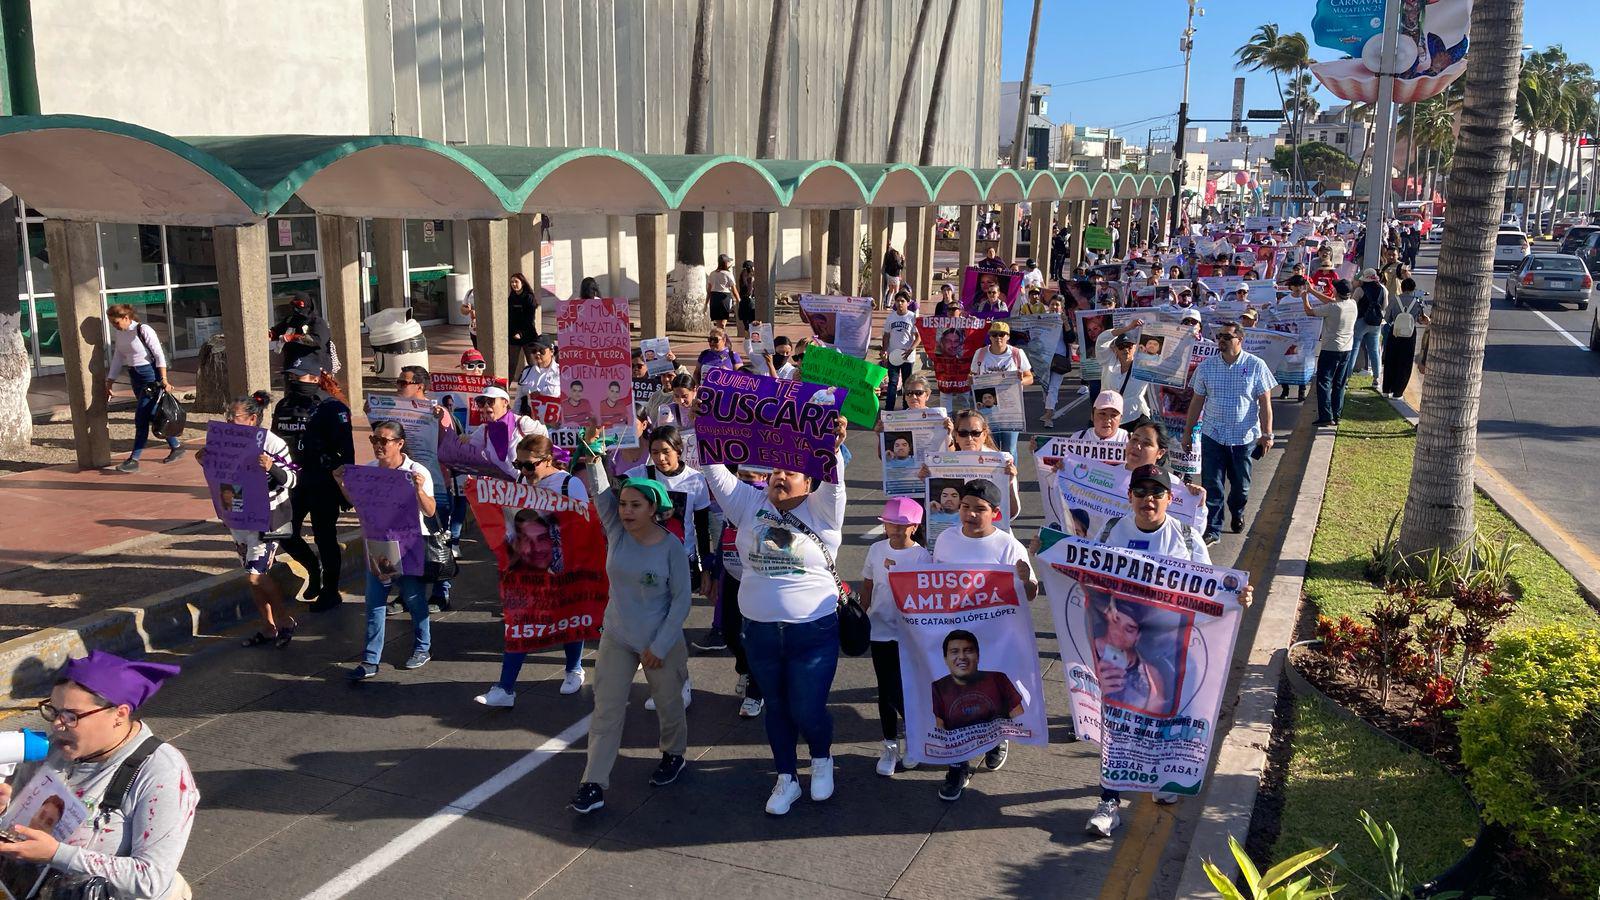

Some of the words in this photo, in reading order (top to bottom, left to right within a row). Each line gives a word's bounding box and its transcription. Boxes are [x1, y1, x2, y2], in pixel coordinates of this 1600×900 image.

[561, 304, 585, 320] SER
[591, 303, 629, 318] MUJER
[558, 322, 575, 334] EN
[576, 321, 628, 334] MAZATLAN
[922, 316, 986, 330] DESAPARECIDO
[570, 336, 586, 347] ES
[590, 336, 628, 348] BUSCAR
[559, 350, 584, 360] ENTRE
[586, 351, 596, 360] LA
[598, 350, 624, 360] TIERRA
[561, 365, 597, 380] QUIEN
[600, 368, 625, 380] AMAS
[436, 384, 467, 392] ESTAMOS
[706, 368, 760, 392] QUIEN
[775, 378, 803, 400] TE
[696, 386, 840, 440] BUSCARA
[278, 422, 306, 431] POLICÍA
[697, 424, 752, 437] CUANDO
[758, 428, 784, 445] YO
[793, 436, 812, 452] YA
[698, 438, 750, 464] NO
[758, 448, 805, 468] ESTE
[814, 448, 838, 483] ?
[1088, 474, 1114, 489] Sinaloa
[476, 478, 591, 523] DESAPARECIDO
[1077, 499, 1103, 513] MANUEL
[1066, 544, 1219, 598] DESAPARECIDO
[1160, 558, 1186, 569] FALTAN
[1190, 564, 1214, 574] TODOS
[917, 572, 986, 590] BUSCO
[902, 594, 944, 611] AMI
[950, 586, 1004, 610] PAPÁ
[1122, 580, 1173, 604] HERNÁNDEZ
[1176, 594, 1224, 617] CAMACHO
[964, 612, 991, 623] LÓPEZ
[992, 608, 1017, 619] LÓPEZ
[1073, 670, 1085, 680] FUE
[1124, 710, 1132, 720] EL
[1134, 713, 1143, 724] 12
[1144, 717, 1154, 727] DE
[1192, 719, 1206, 730] DEL
[1102, 768, 1158, 784] 262089
[1163, 765, 1198, 777] CASA!
